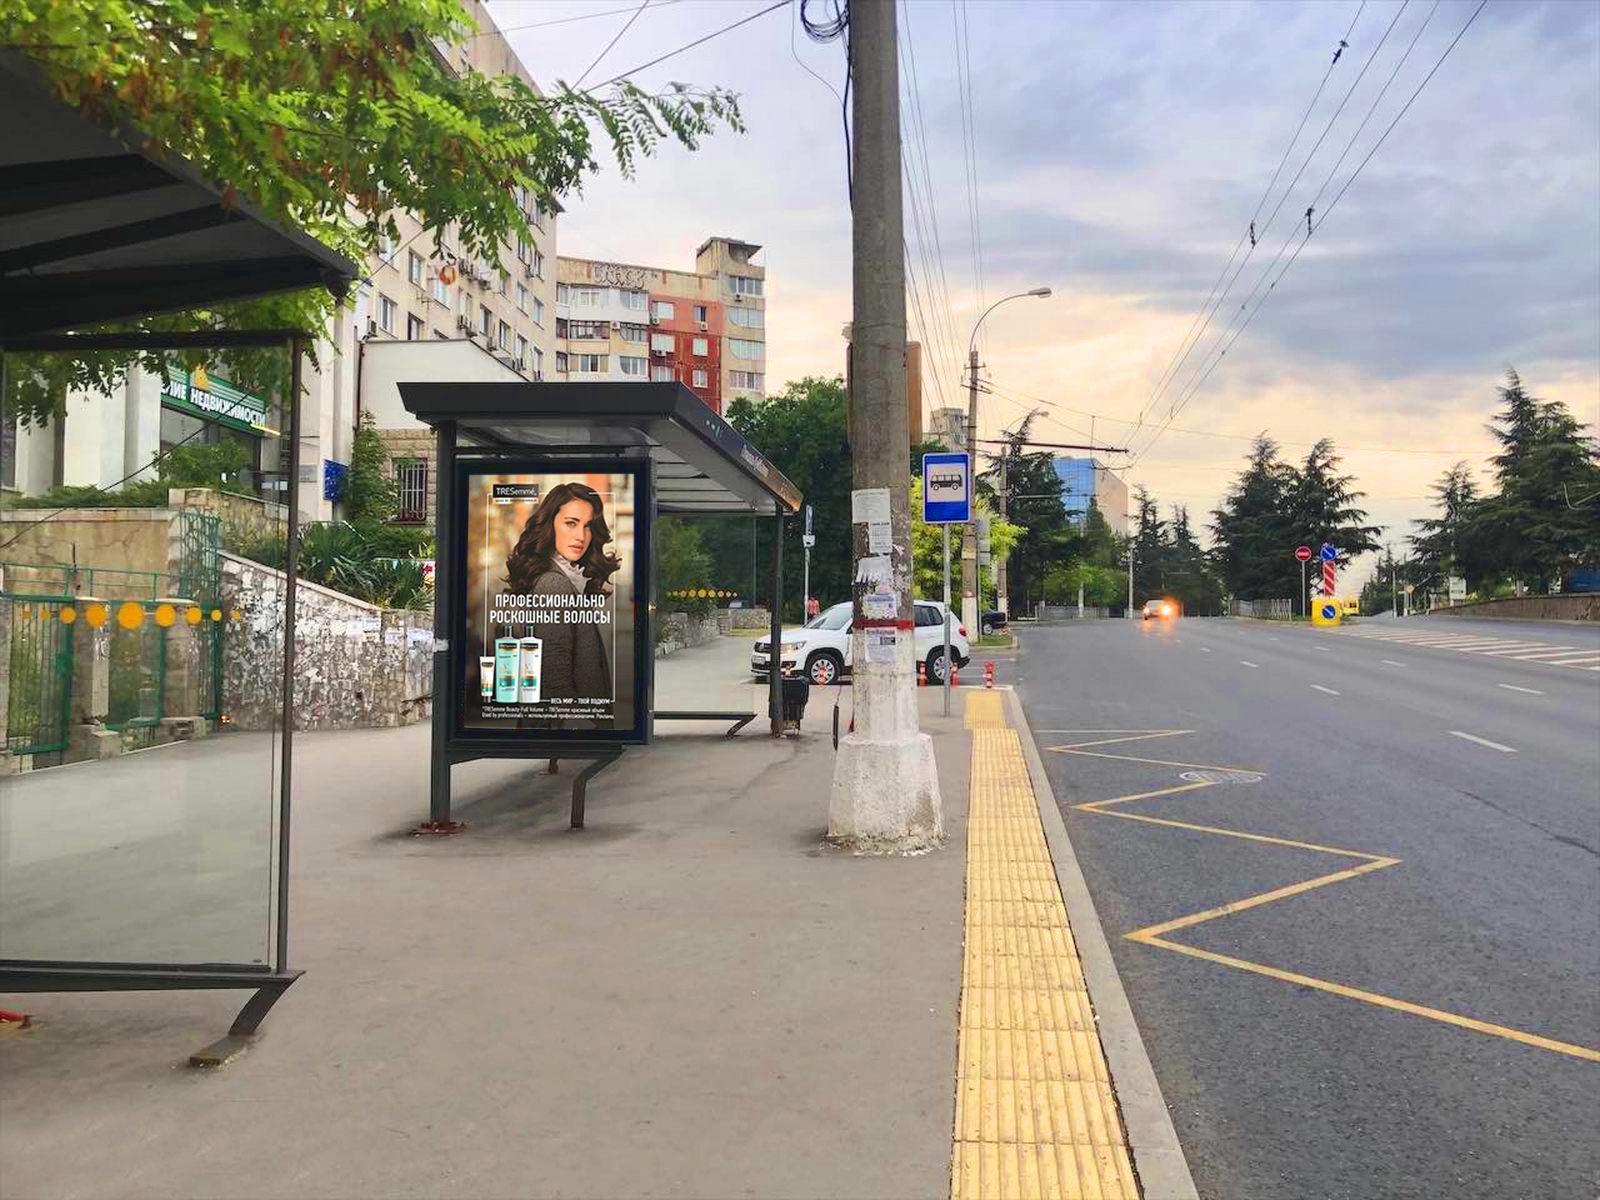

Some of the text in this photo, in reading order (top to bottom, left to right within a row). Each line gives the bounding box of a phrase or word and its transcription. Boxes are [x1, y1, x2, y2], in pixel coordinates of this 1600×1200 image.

[495, 594, 605, 608] ПРОФЕССИОНАЛЬНО
[490, 610, 610, 624] РОСКОШНЫЕ ВОЛОСЫ
